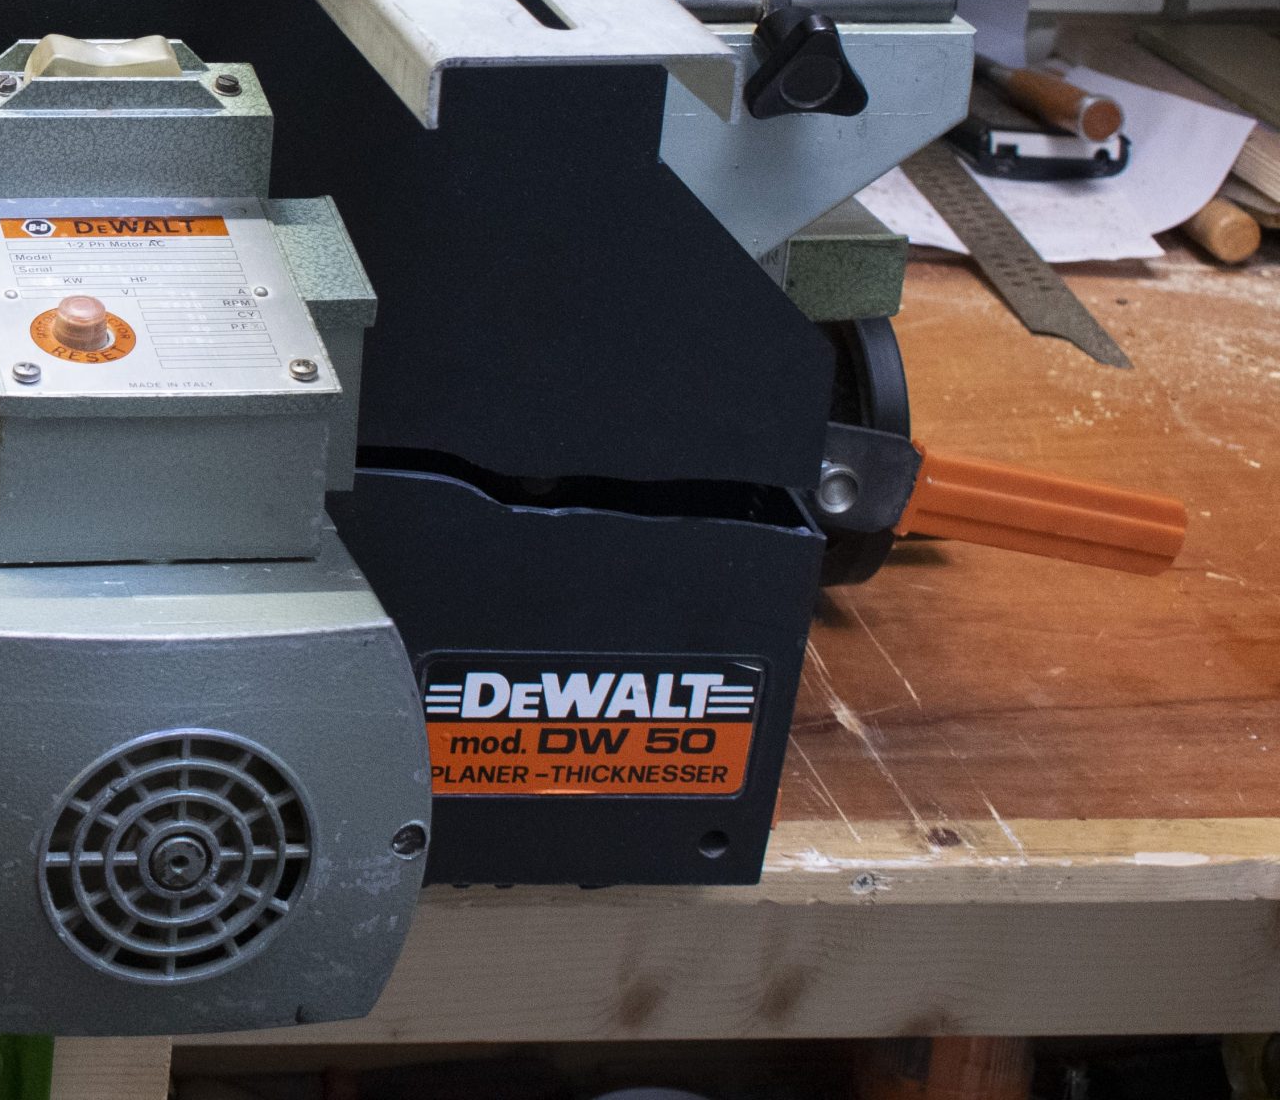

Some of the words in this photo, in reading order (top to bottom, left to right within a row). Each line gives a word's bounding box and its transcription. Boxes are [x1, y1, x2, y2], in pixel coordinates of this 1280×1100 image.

[15, 253, 52, 261] Model
[52, 346, 126, 363] RESET
[450, 729, 527, 754] mod.
[537, 728, 629, 754] DW
[645, 728, 716, 754] 50
[432, 766, 529, 783] PLANER
